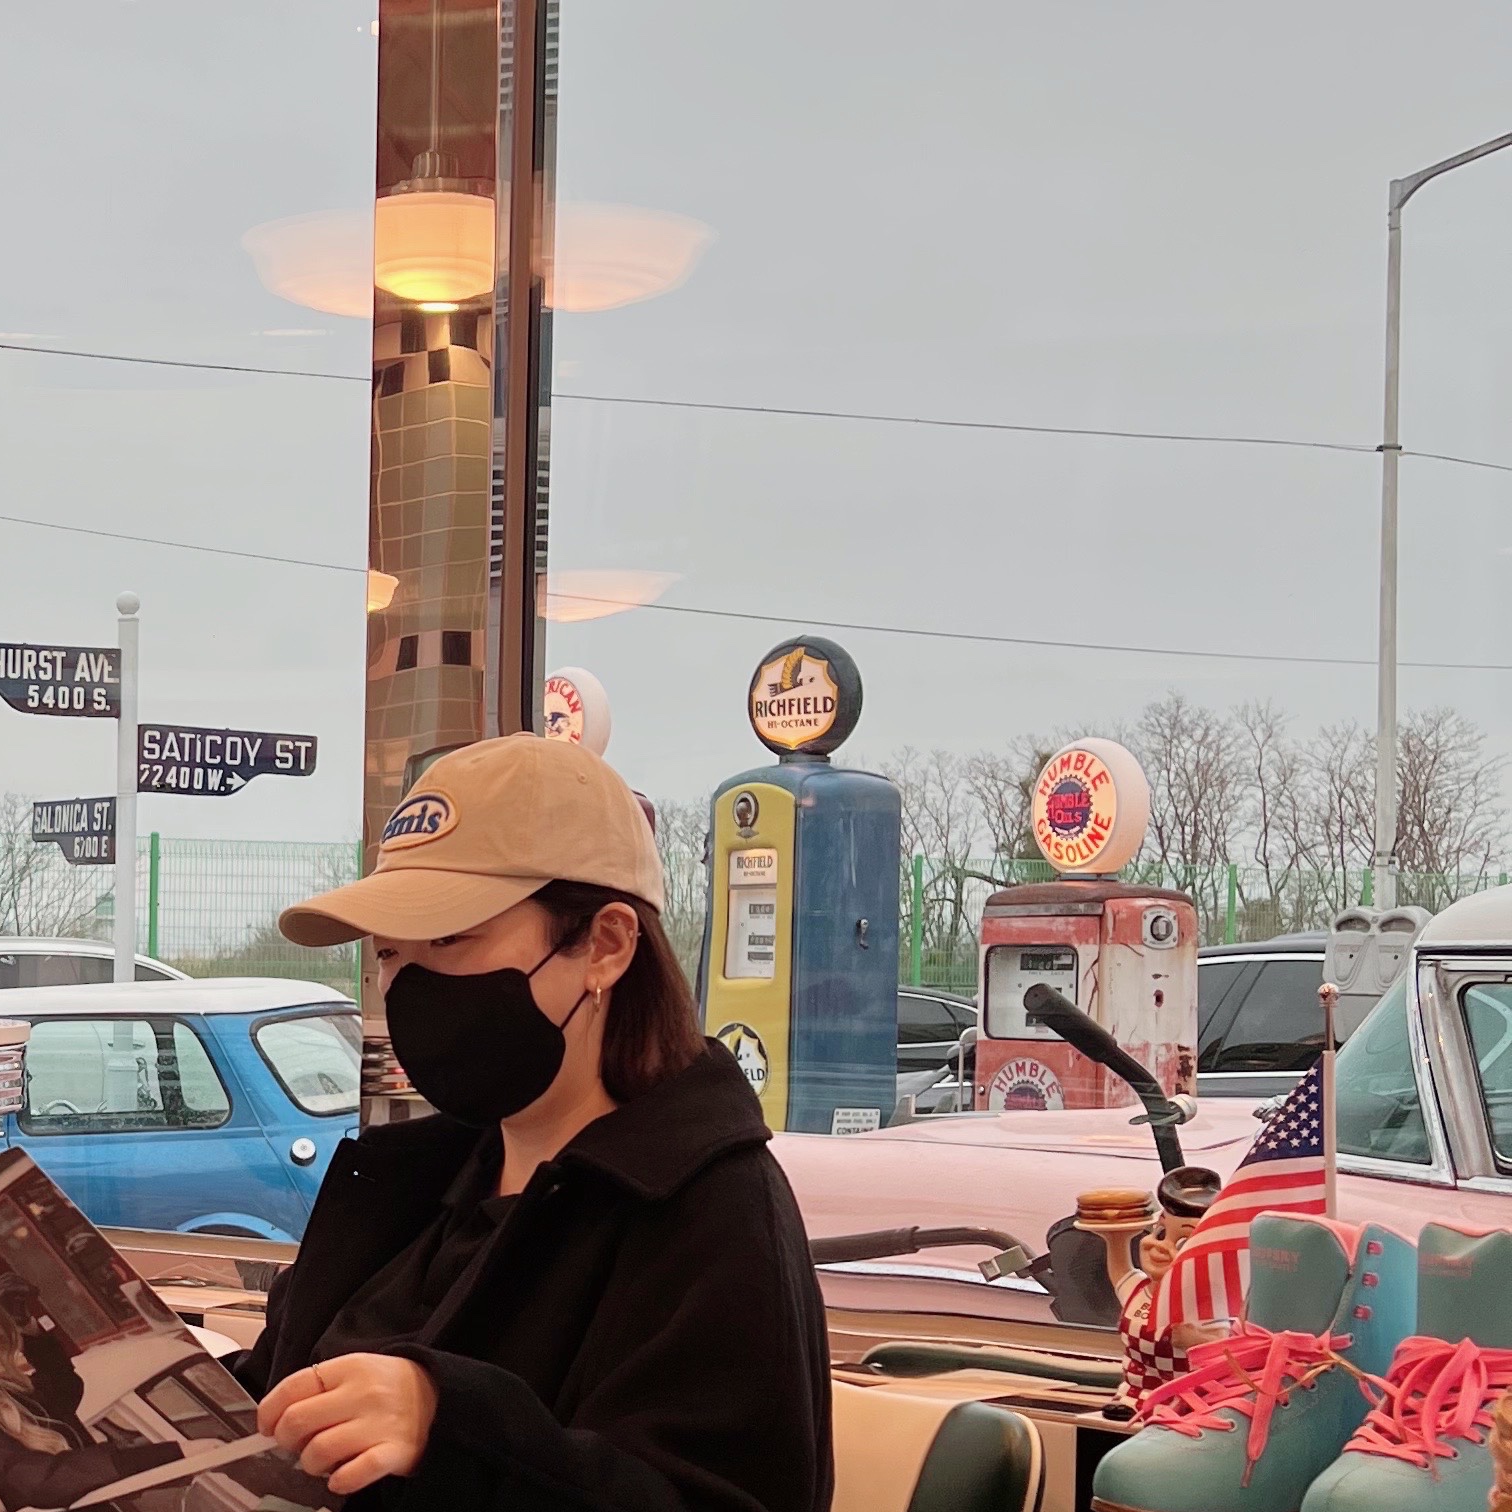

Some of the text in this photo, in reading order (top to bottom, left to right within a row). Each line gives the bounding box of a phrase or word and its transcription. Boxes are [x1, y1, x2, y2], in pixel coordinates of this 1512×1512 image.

[74, 652, 120, 684] AVE
[27, 685, 110, 711] 5400 S.
[755, 697, 835, 718] RICHFIELD
[768, 719, 819, 729] HI-OCTANE
[143, 730, 312, 770] SATICOY ST
[1039, 753, 1109, 796] HUMBLE
[34, 802, 112, 834] SALONICA ST.
[1037, 813, 1112, 863] GASOLINE
[737, 856, 773, 869] RICHFIELD
[994, 1061, 1058, 1099] HUMBLE
